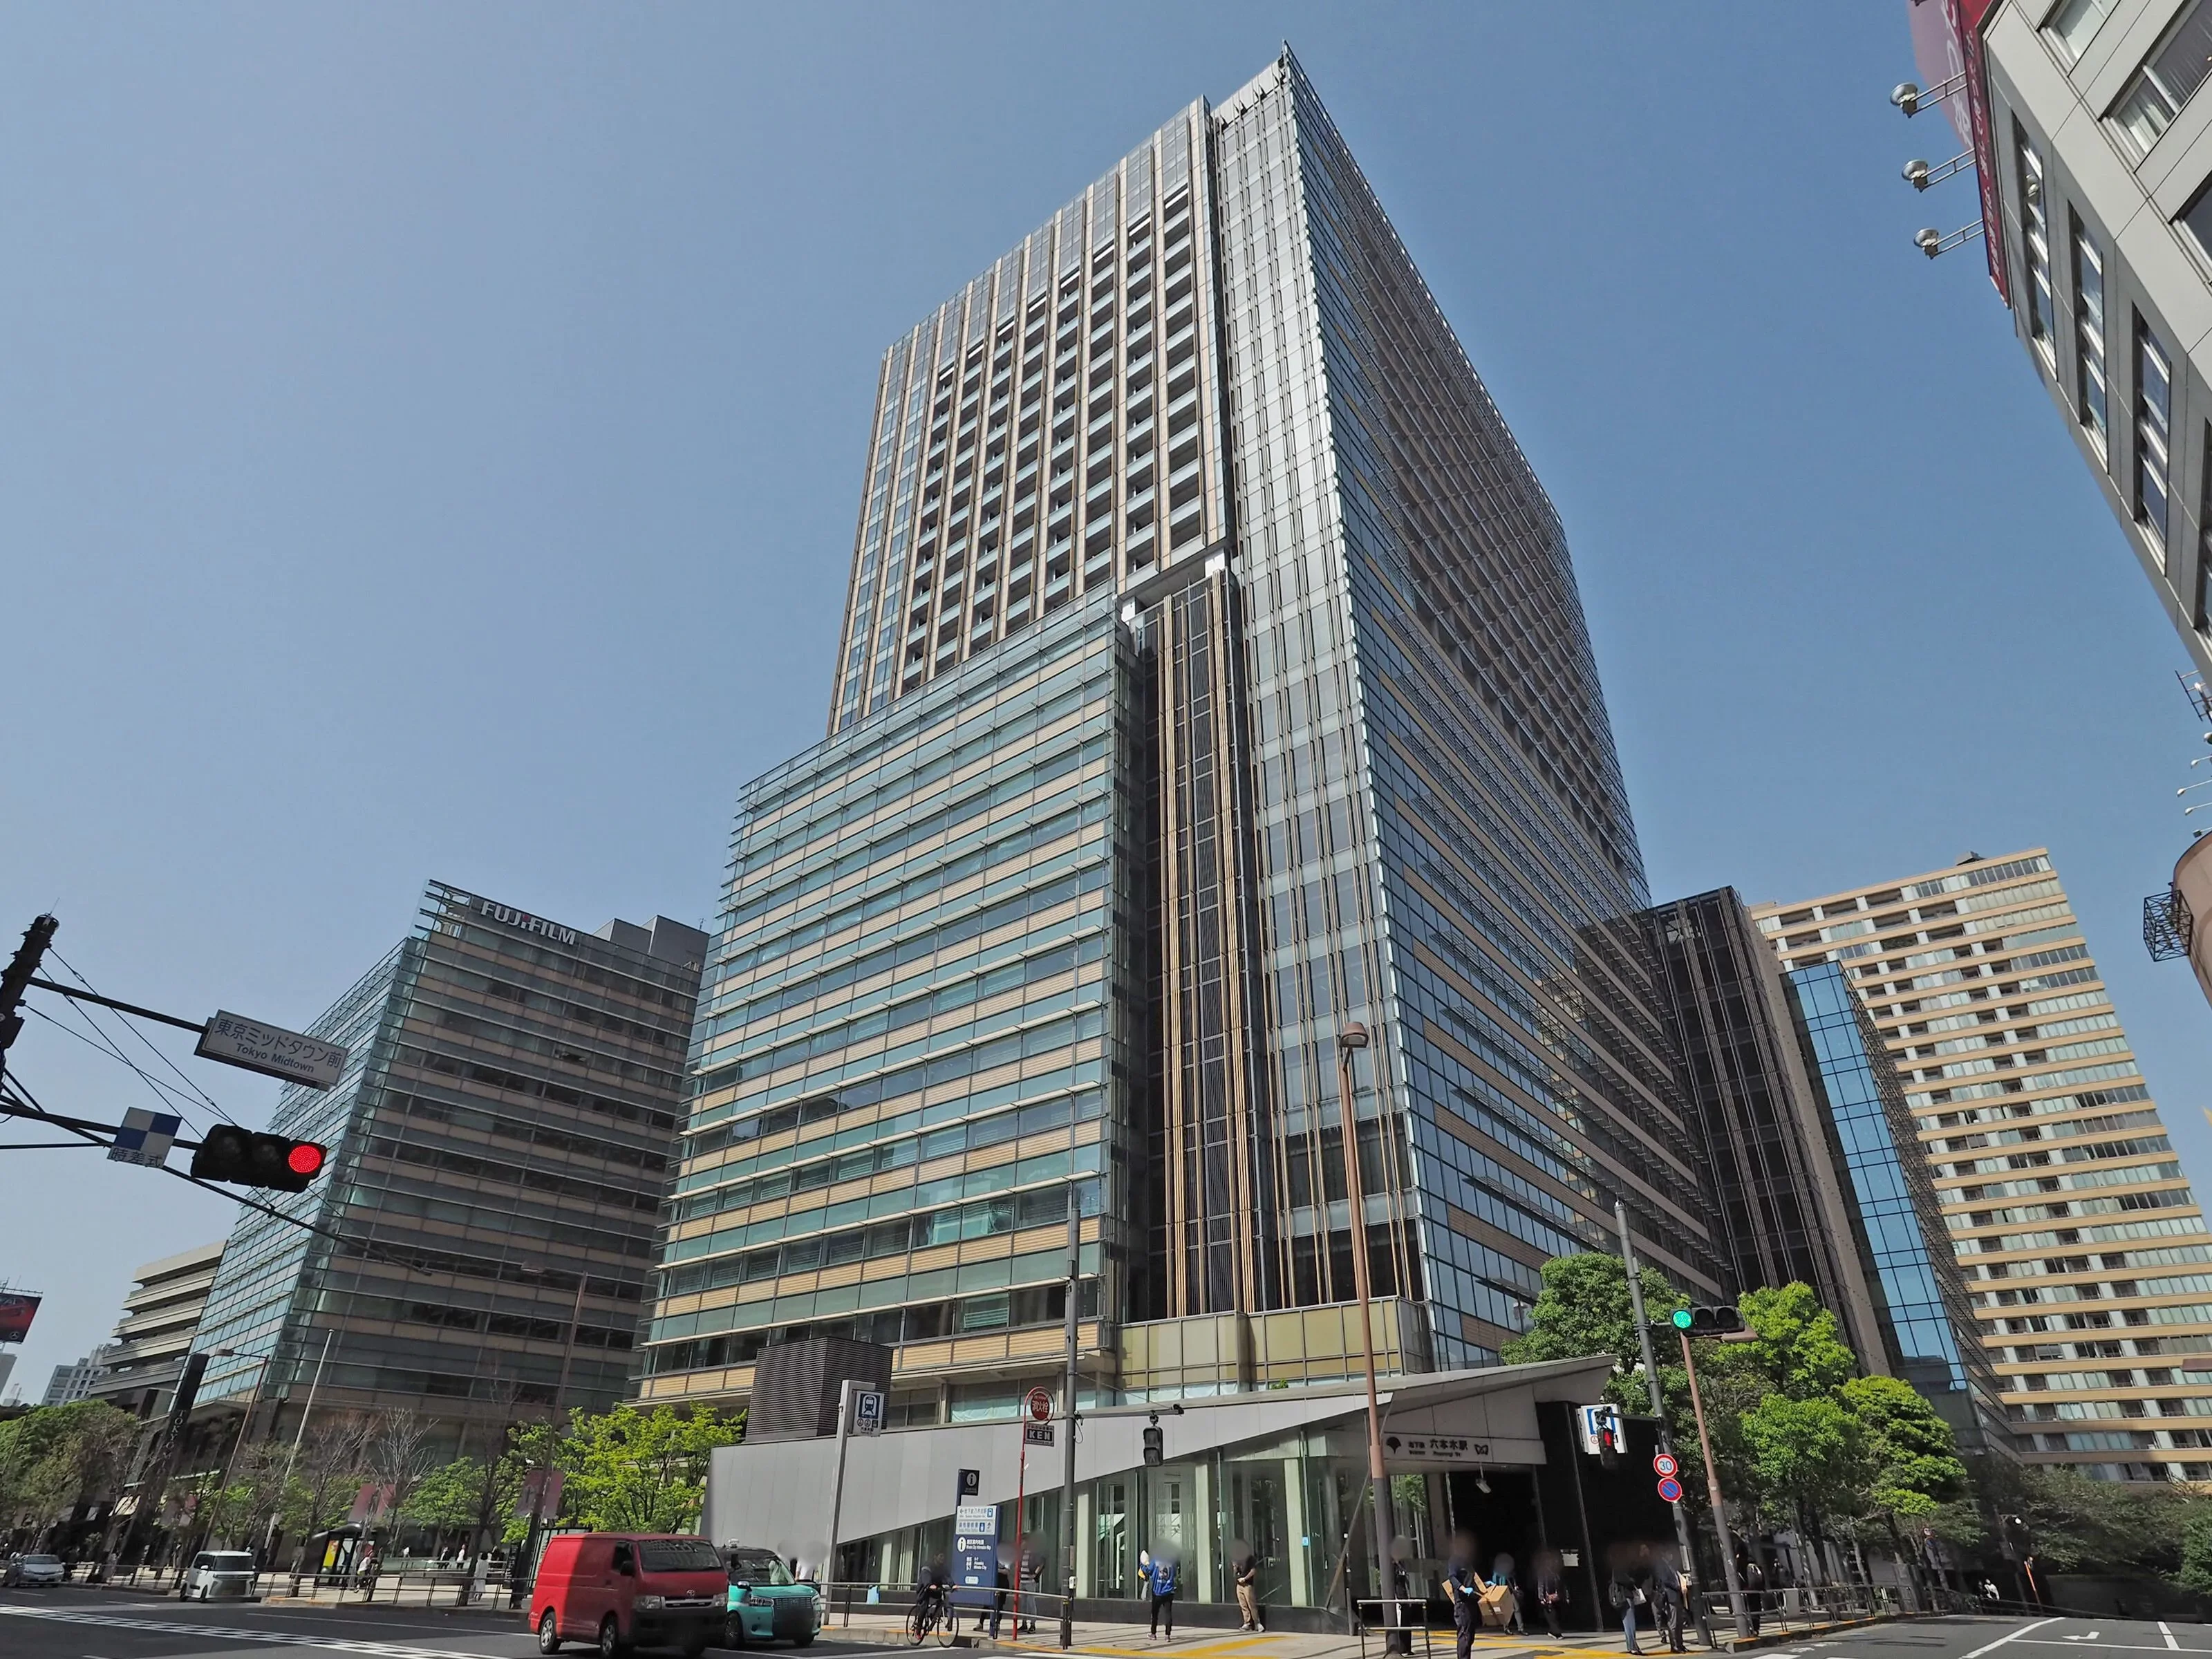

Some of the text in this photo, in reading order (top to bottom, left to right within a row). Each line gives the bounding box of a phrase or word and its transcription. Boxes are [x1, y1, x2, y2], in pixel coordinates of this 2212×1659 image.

[480, 901, 577, 945] FUJIFILM
[214, 1018, 342, 1068] 東京ミッドタウン前
[236, 1042, 314, 1073] Tokyo Midtown
[111, 1147, 163, 1167] 時差式
[1032, 1400, 1049, 1413] 消火栓
[166, 1409, 186, 1449] TOKYO
[1029, 1430, 1051, 1441] KEN
[1430, 1438, 1468, 1450] 六本木駅
[1659, 1461, 1672, 1471] 30
